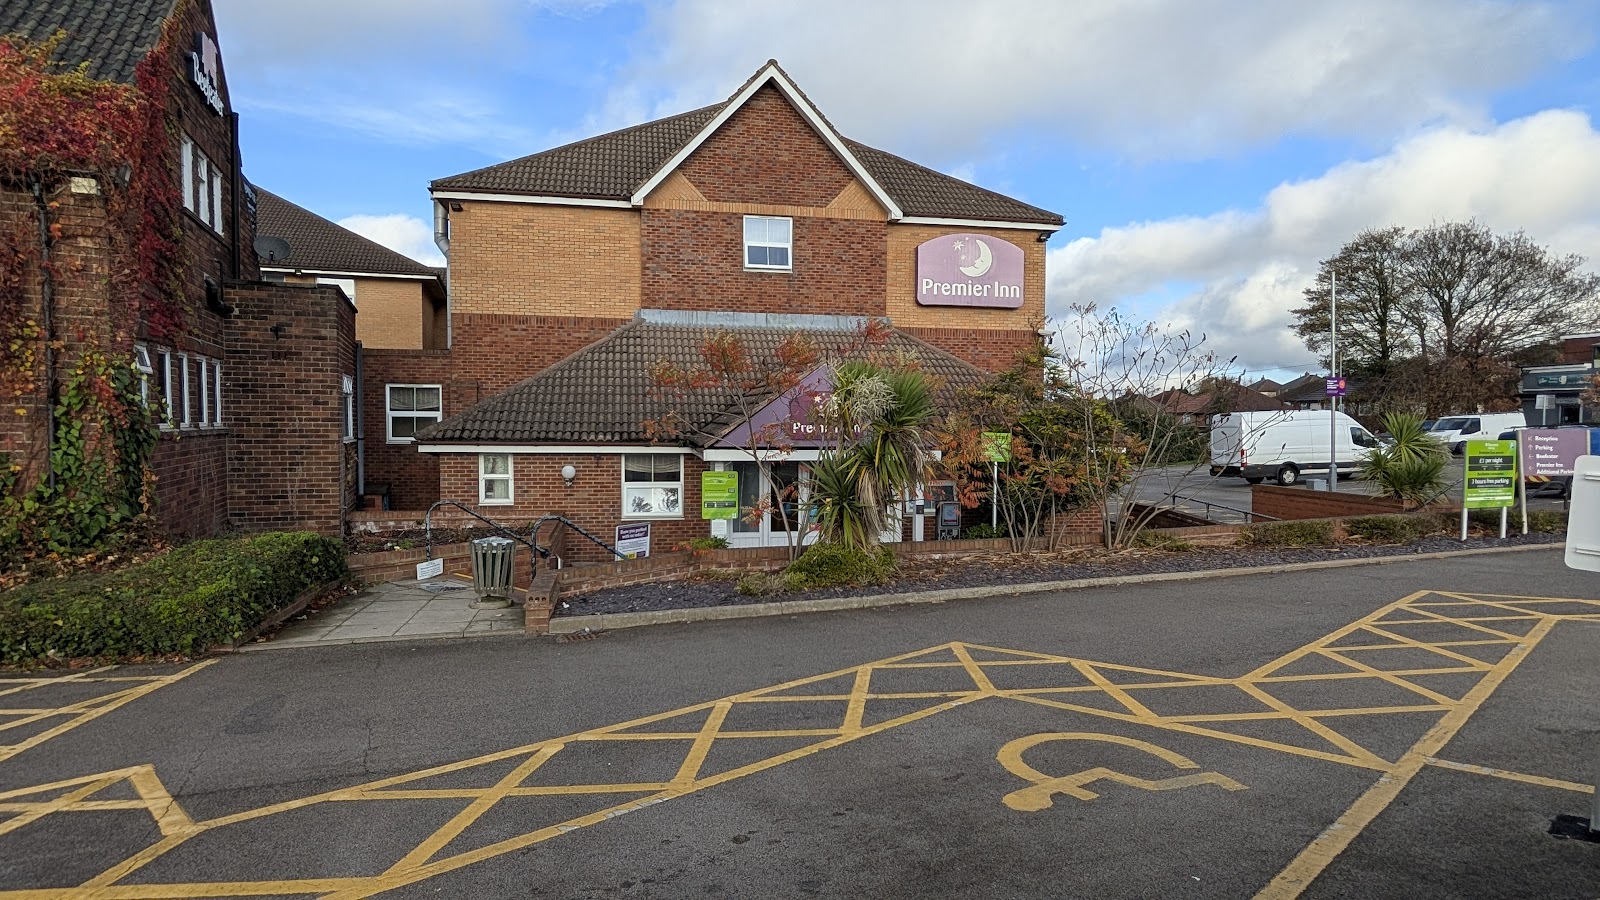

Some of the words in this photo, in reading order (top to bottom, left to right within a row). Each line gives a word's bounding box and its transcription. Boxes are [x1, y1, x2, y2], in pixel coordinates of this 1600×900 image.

[193, 52, 224, 117] Beefeater
[922, 278, 992, 297] Premier
[994, 281, 1020, 298] Inn
[1494, 477, 1510, 485] parking
